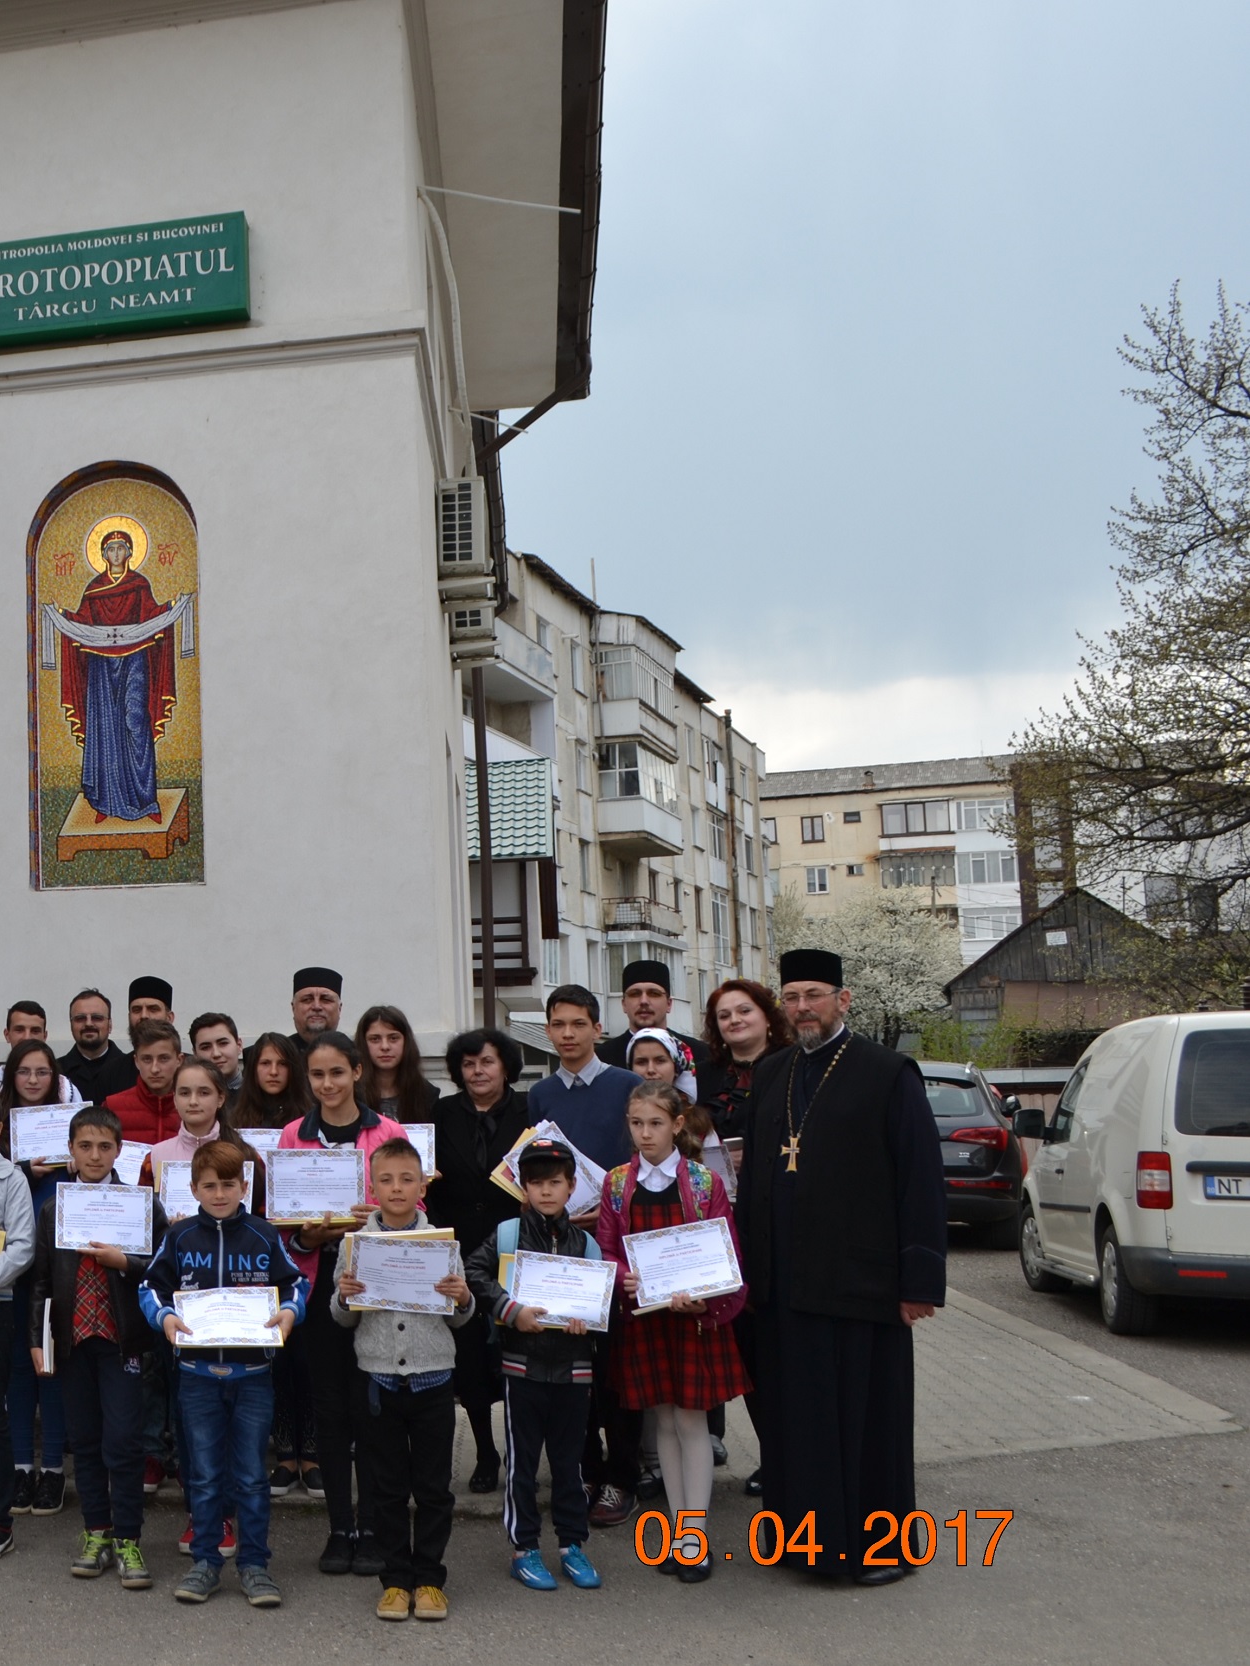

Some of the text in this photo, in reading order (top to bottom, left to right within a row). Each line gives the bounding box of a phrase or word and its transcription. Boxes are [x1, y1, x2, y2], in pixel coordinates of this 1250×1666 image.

[67, 234, 132, 252] MOLDOVEI
[153, 222, 224, 241] BUCOVINEI
[14, 299, 96, 321] TÂRGU
[1217, 1178, 1242, 1194] NT
